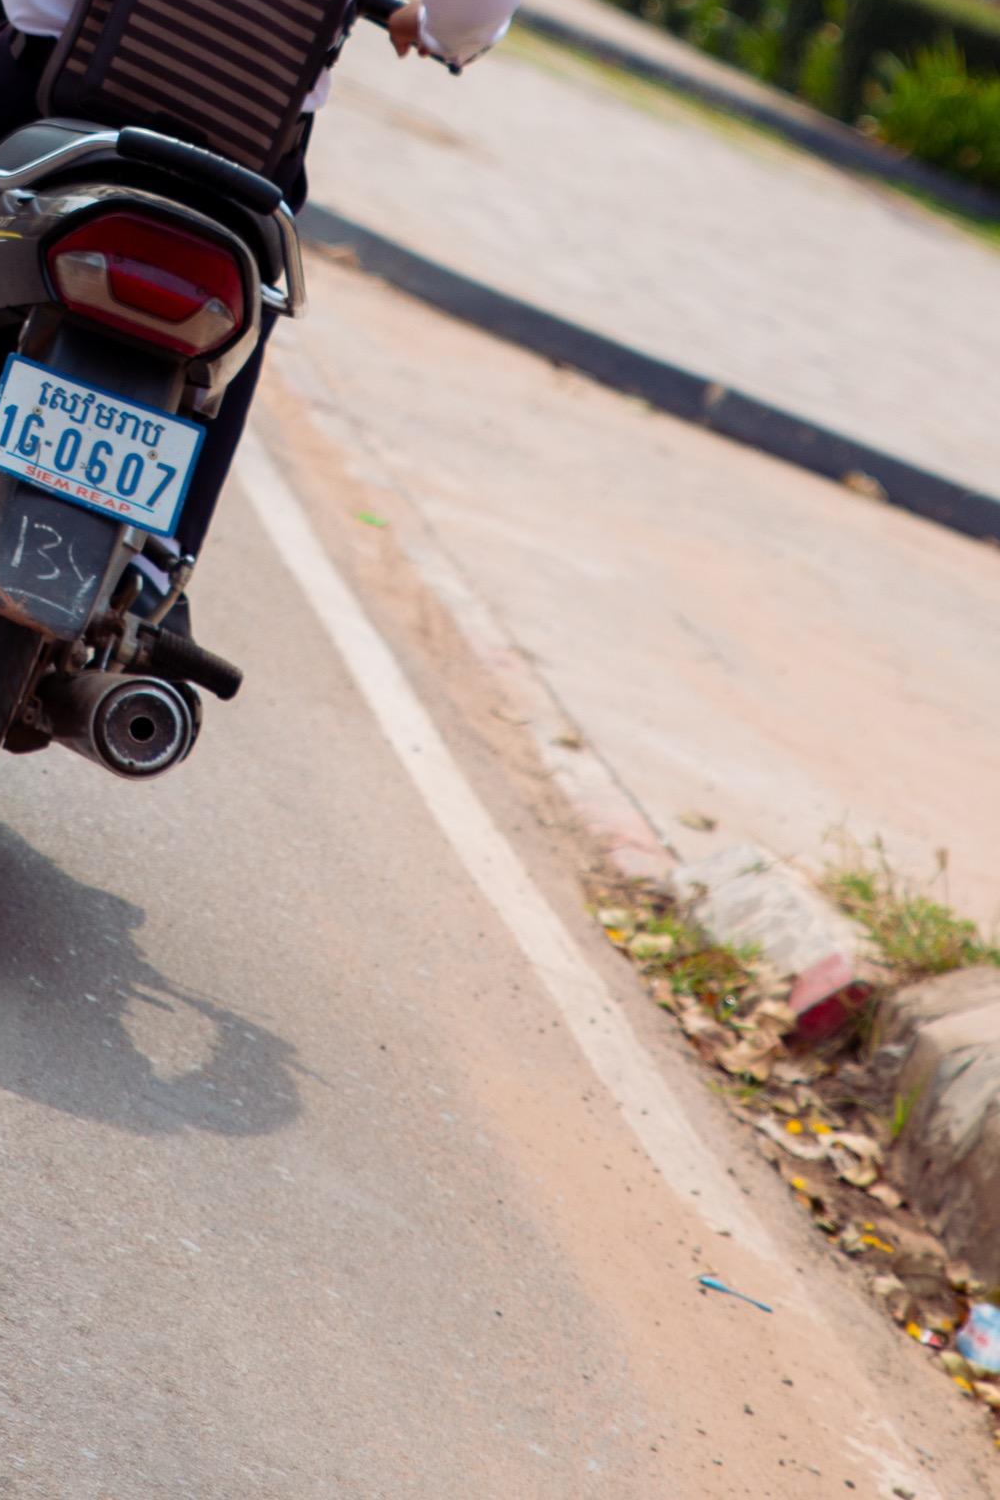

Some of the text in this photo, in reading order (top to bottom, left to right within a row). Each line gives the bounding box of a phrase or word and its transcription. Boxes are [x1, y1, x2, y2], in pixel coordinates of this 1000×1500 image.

[0, 404, 177, 507] 1G-0607
[25, 464, 132, 513] SIEM REAP
